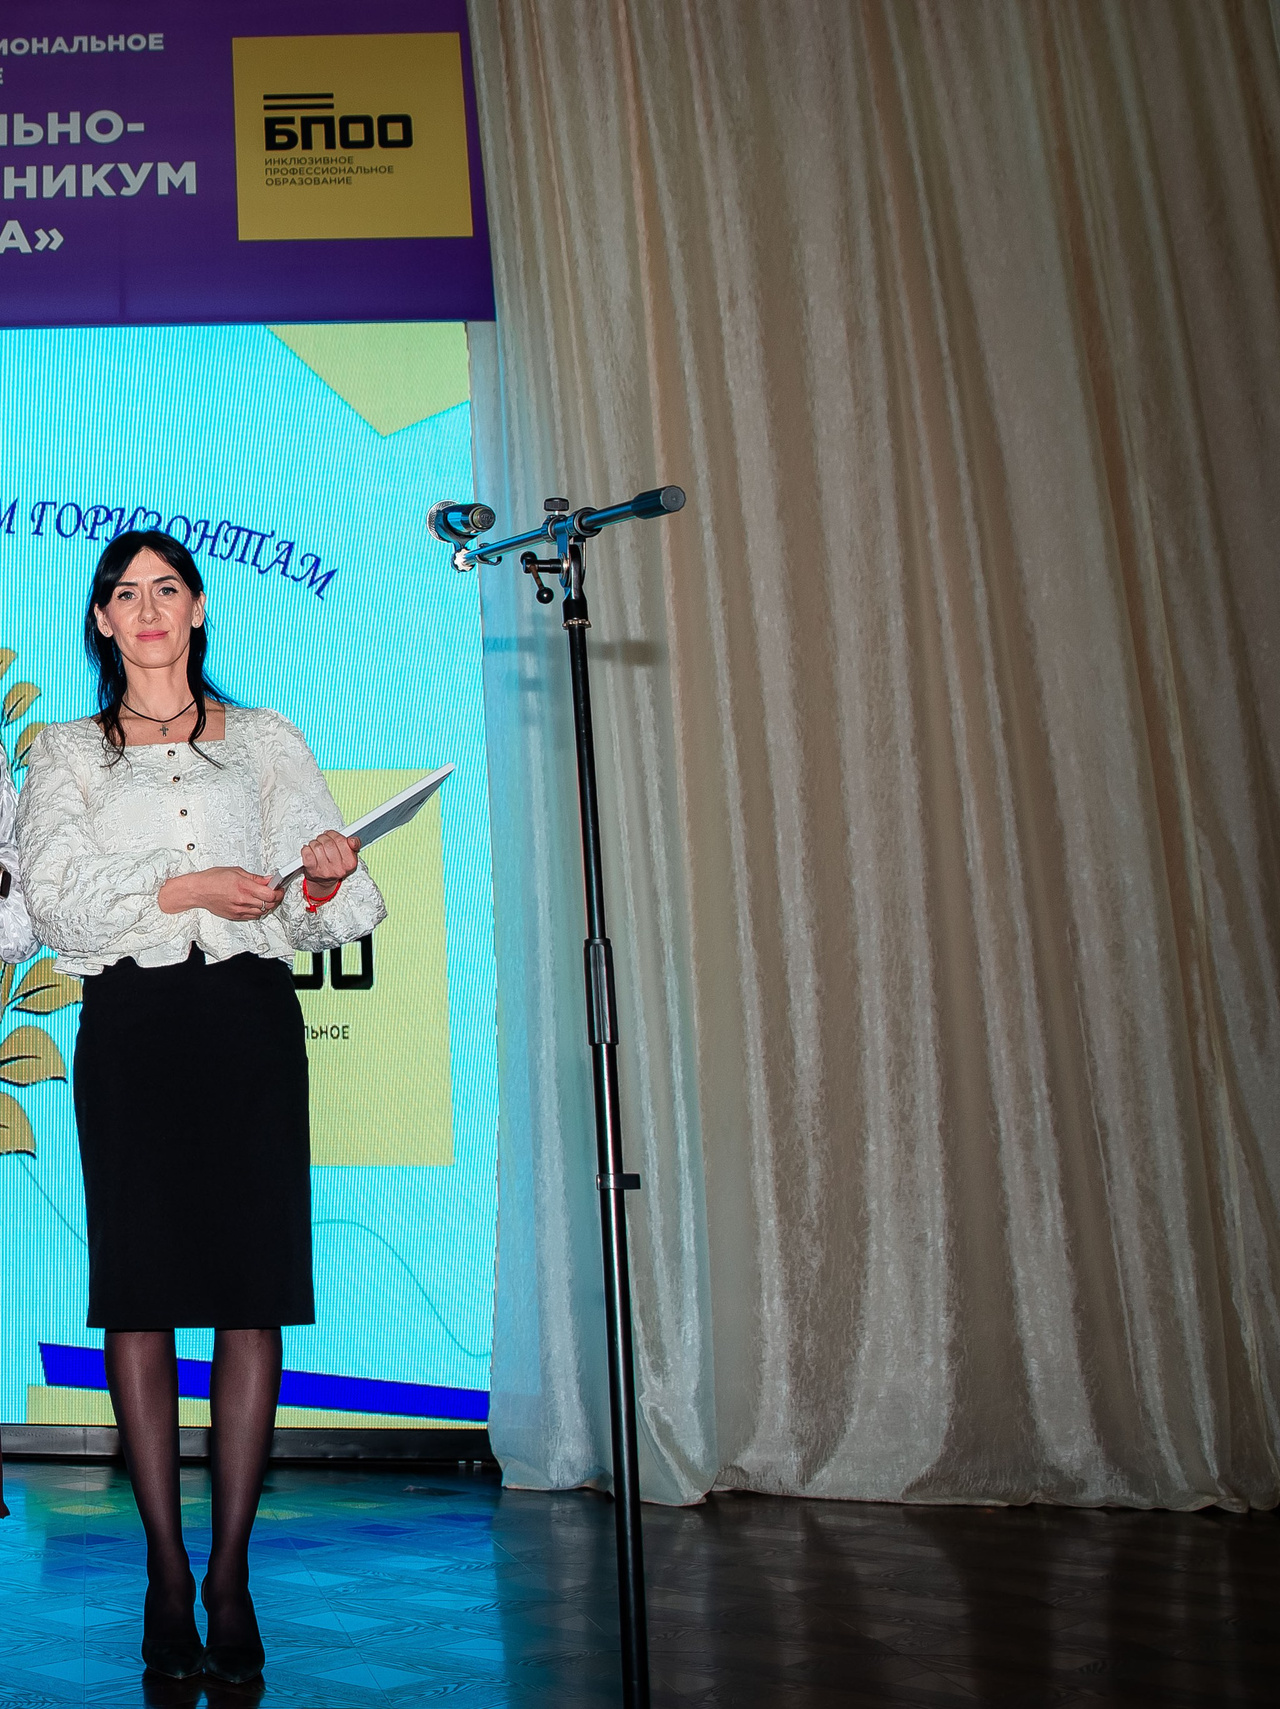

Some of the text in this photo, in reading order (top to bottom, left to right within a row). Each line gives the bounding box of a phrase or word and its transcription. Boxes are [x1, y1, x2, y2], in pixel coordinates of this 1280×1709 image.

[264, 114, 413, 151] БПОО
[264, 155, 354, 166] ИНКЛЮЗИВНОЕ
[265, 165, 394, 176] ПРОФЕССИОНАЛЬНОЕ
[265, 176, 353, 186] ОБРАЗОВАНИЕ
[30, 501, 338, 601] ГОРИЗОНТАМ
